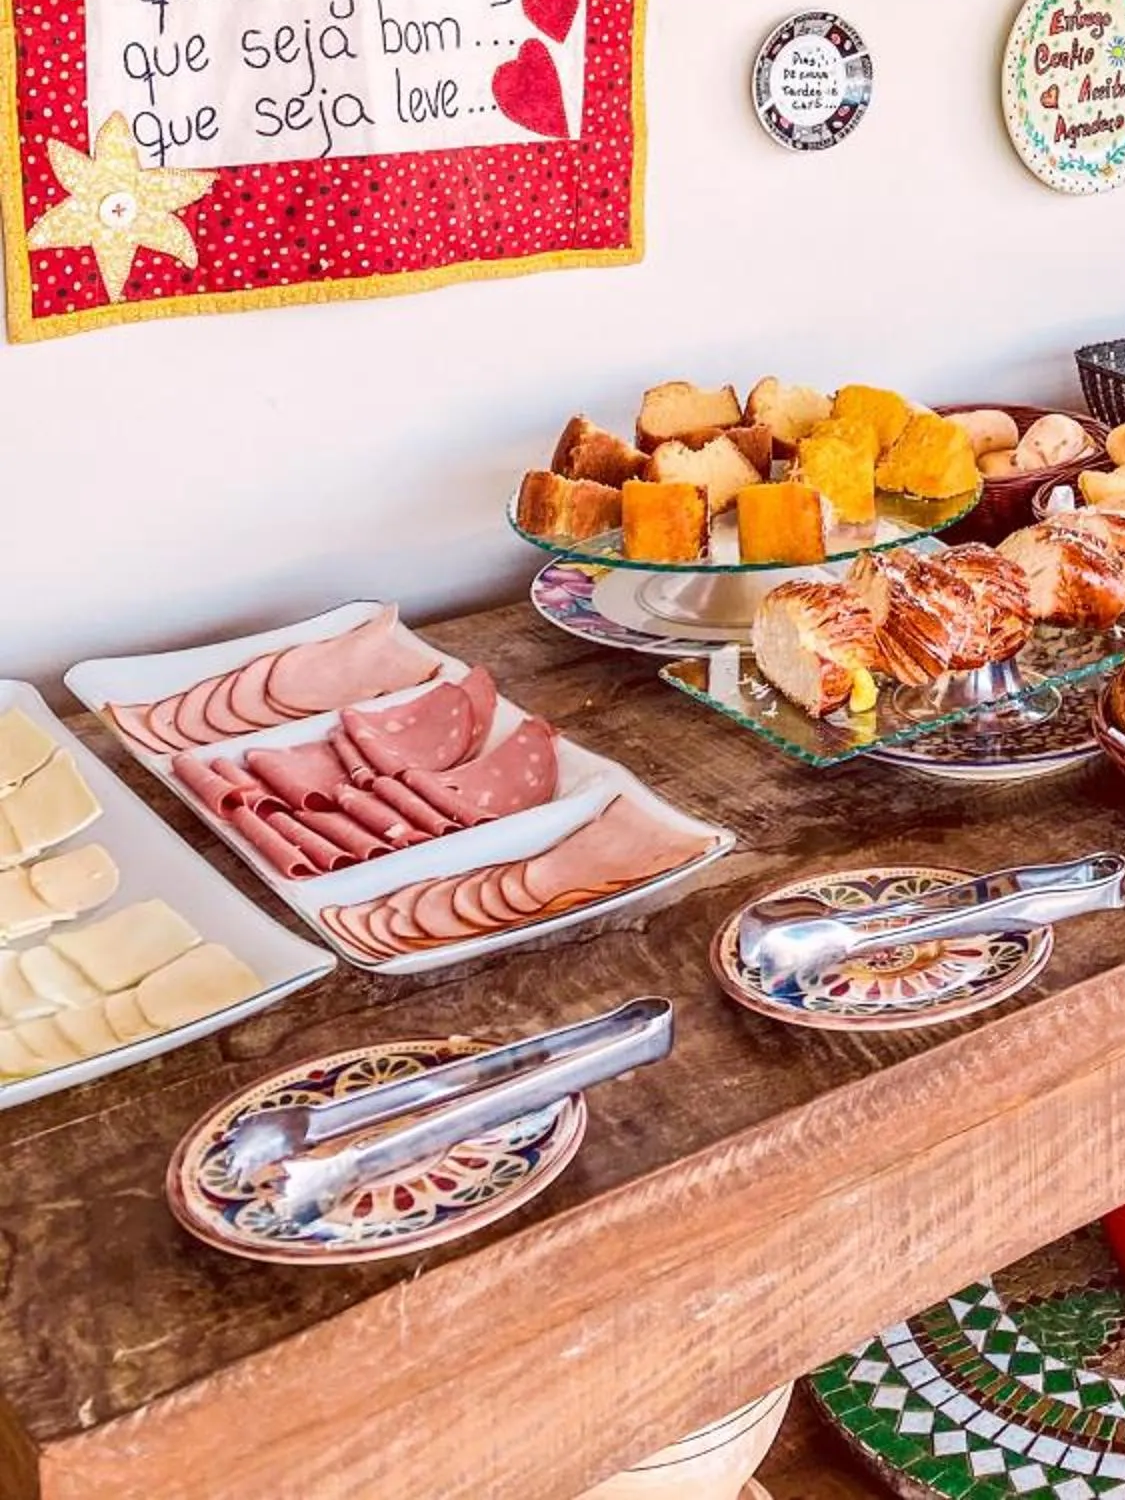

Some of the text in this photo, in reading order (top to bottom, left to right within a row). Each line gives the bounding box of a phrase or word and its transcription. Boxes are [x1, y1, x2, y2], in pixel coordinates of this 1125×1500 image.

[123, 34, 210, 106] que
[241, 19, 358, 97] seja
[132, 106, 219, 167] que
[255, 88, 375, 159] seja
